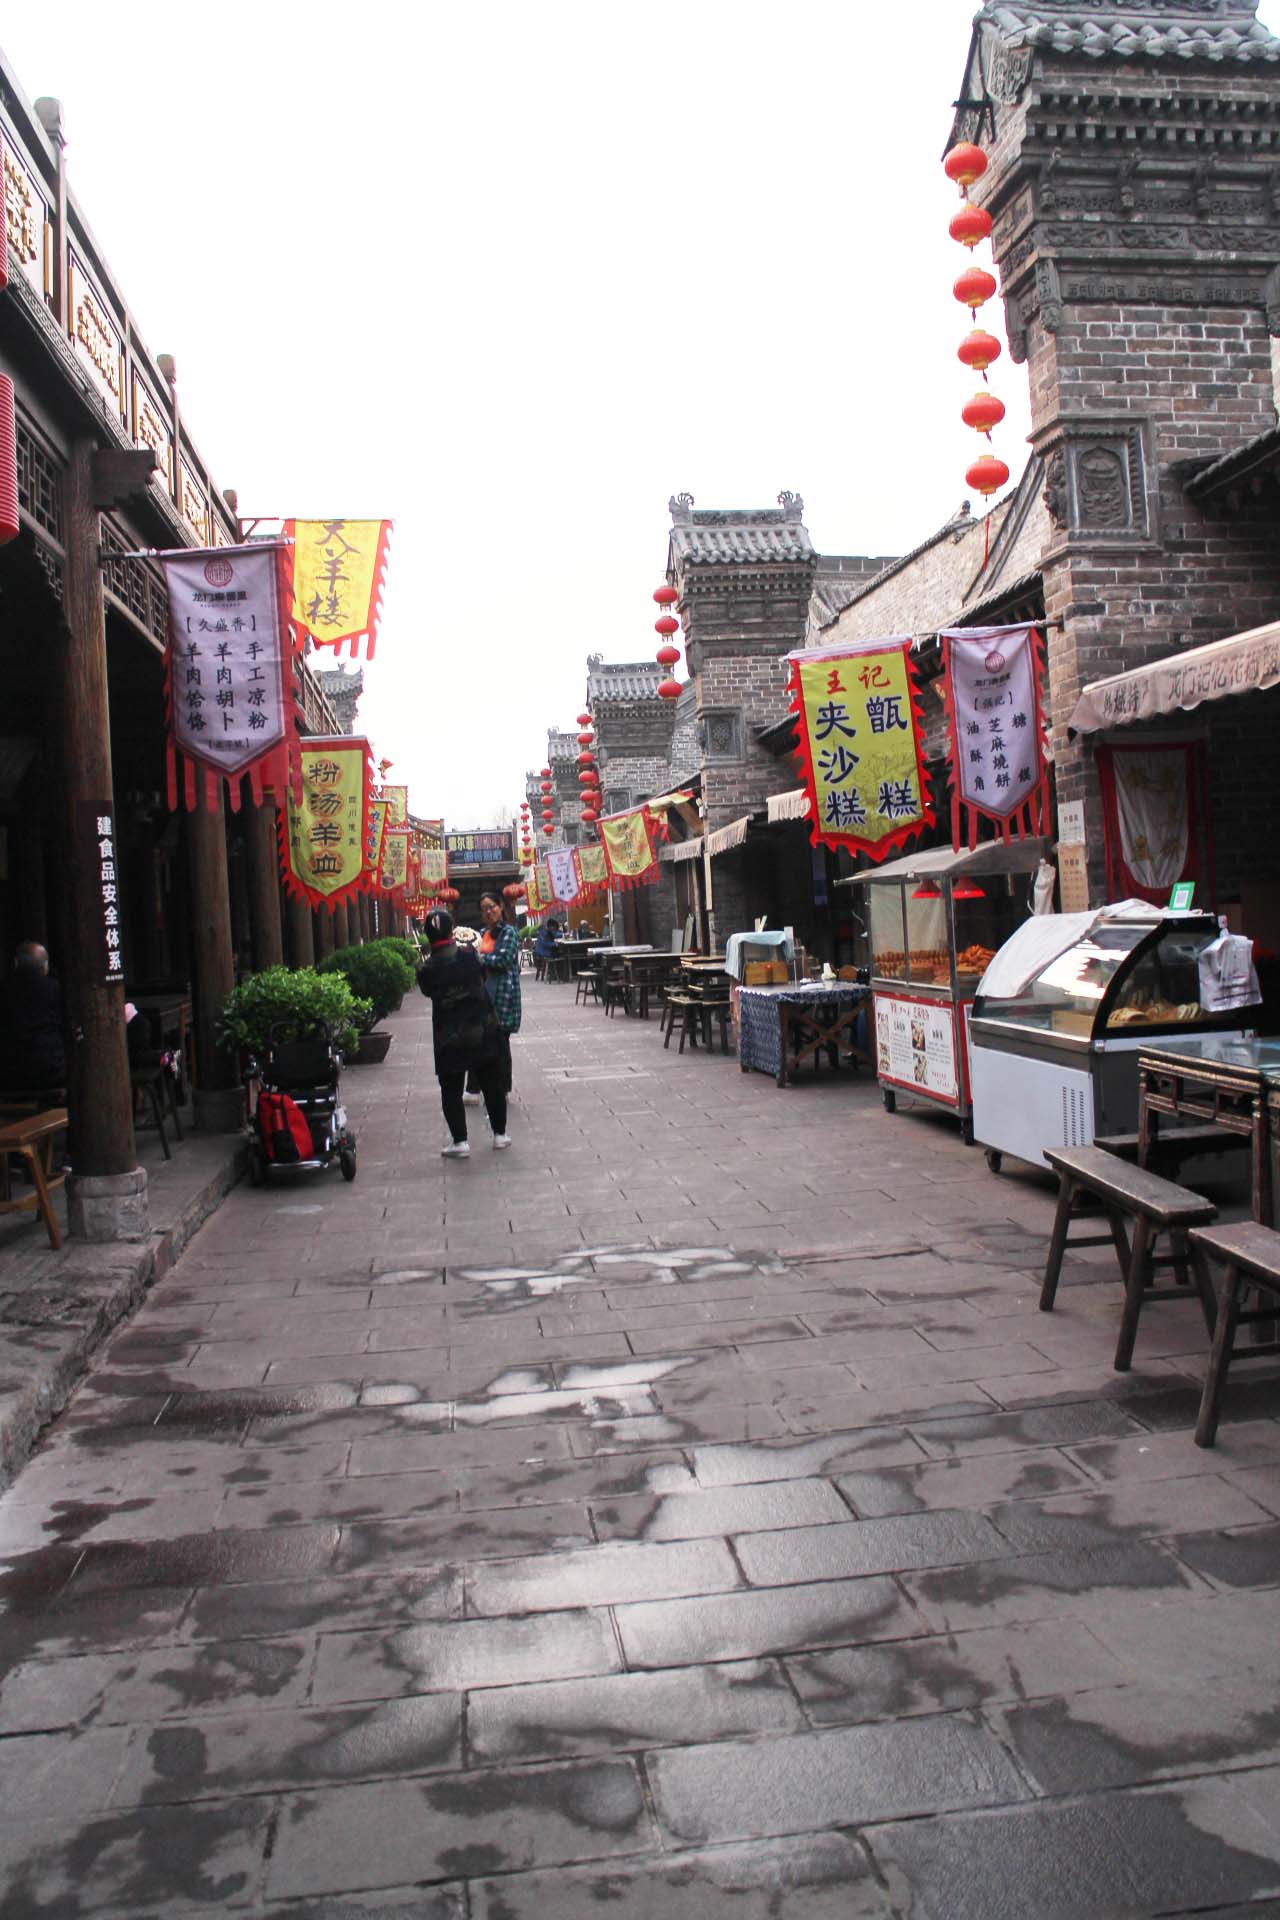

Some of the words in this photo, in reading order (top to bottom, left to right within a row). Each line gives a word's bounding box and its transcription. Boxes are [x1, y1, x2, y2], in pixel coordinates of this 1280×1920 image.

[213, 642, 235, 731] 羊肉胡卜
[245, 641, 269, 730] 手工凉粉
[826, 665, 891, 694] 王记
[815, 701, 866, 826] 夹沙糕
[866, 695, 918, 818] 甑糕
[966, 721, 985, 791] 油酥角
[307, 762, 342, 875] 粉汤羊血
[96, 815, 122, 971] 建食品安全体系
